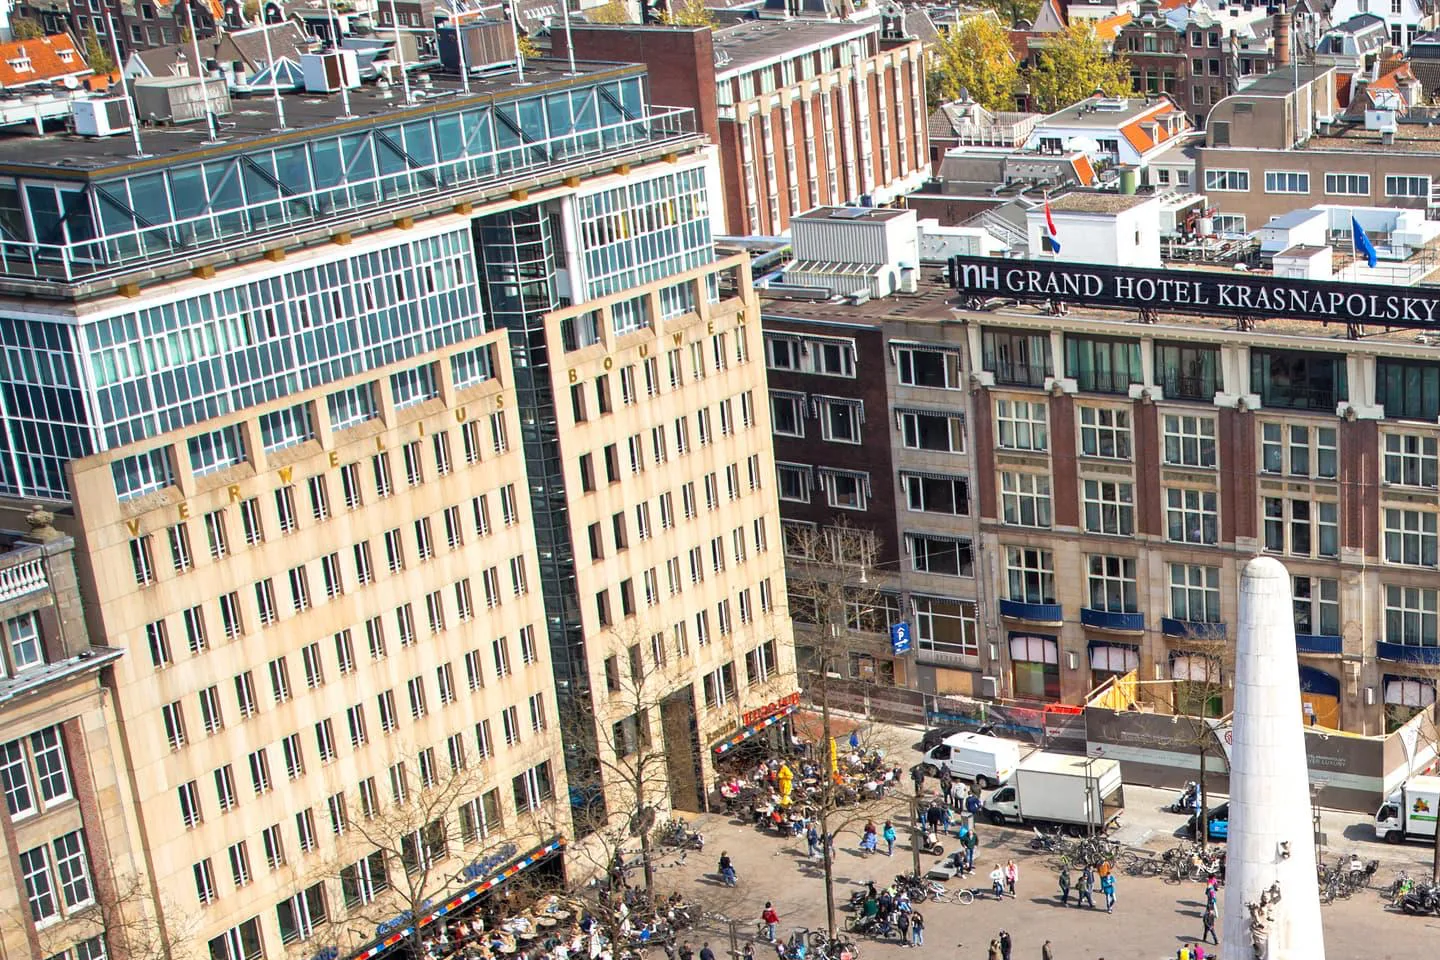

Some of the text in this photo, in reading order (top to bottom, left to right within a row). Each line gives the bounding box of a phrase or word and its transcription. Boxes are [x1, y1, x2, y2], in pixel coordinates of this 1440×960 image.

[1005, 268, 1104, 297] GRAND
[1114, 276, 1210, 305] HOTEL
[1216, 284, 1440, 322] KRASNAPOLSKY
[125, 310, 746, 538] VERWELIUS BOUWEN
